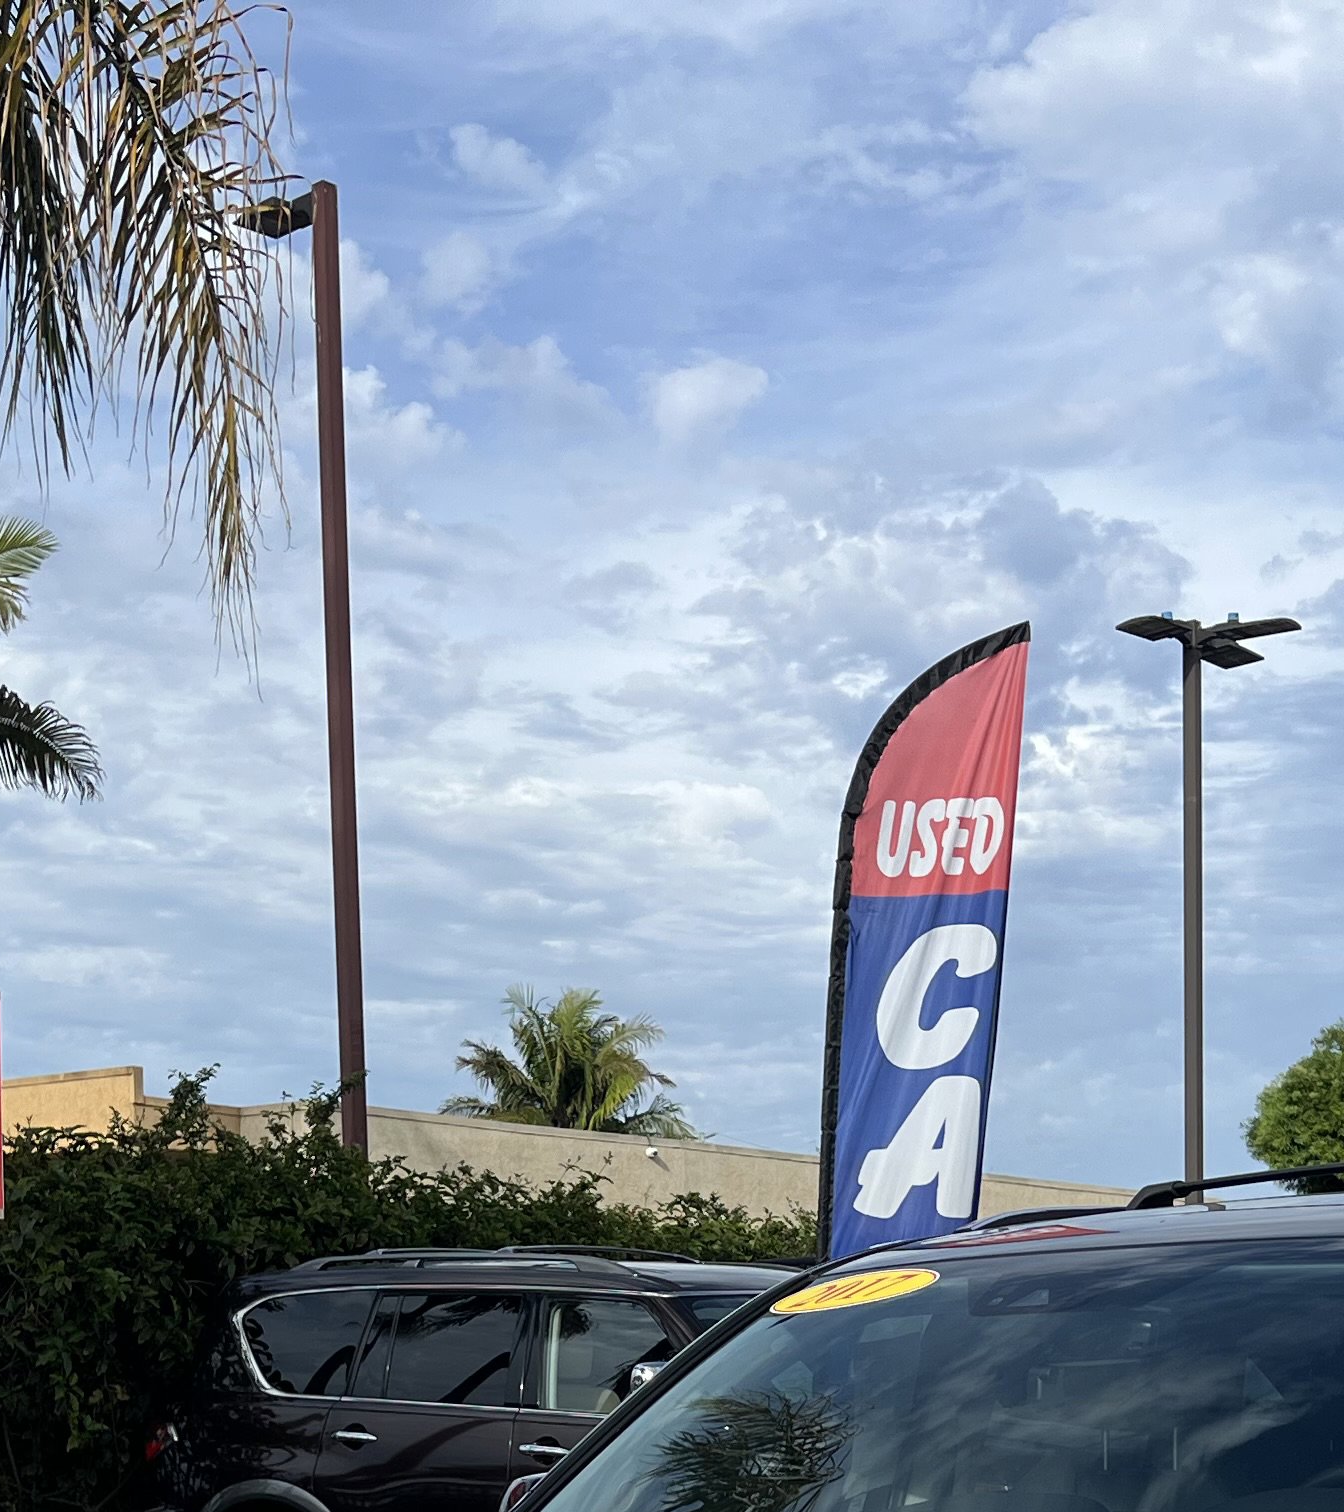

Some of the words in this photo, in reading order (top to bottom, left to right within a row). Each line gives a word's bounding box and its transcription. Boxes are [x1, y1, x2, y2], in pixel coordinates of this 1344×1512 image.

[875, 796, 1005, 877] USED
[852, 923, 998, 1249] CA
[787, 1274, 920, 1308] 2017
